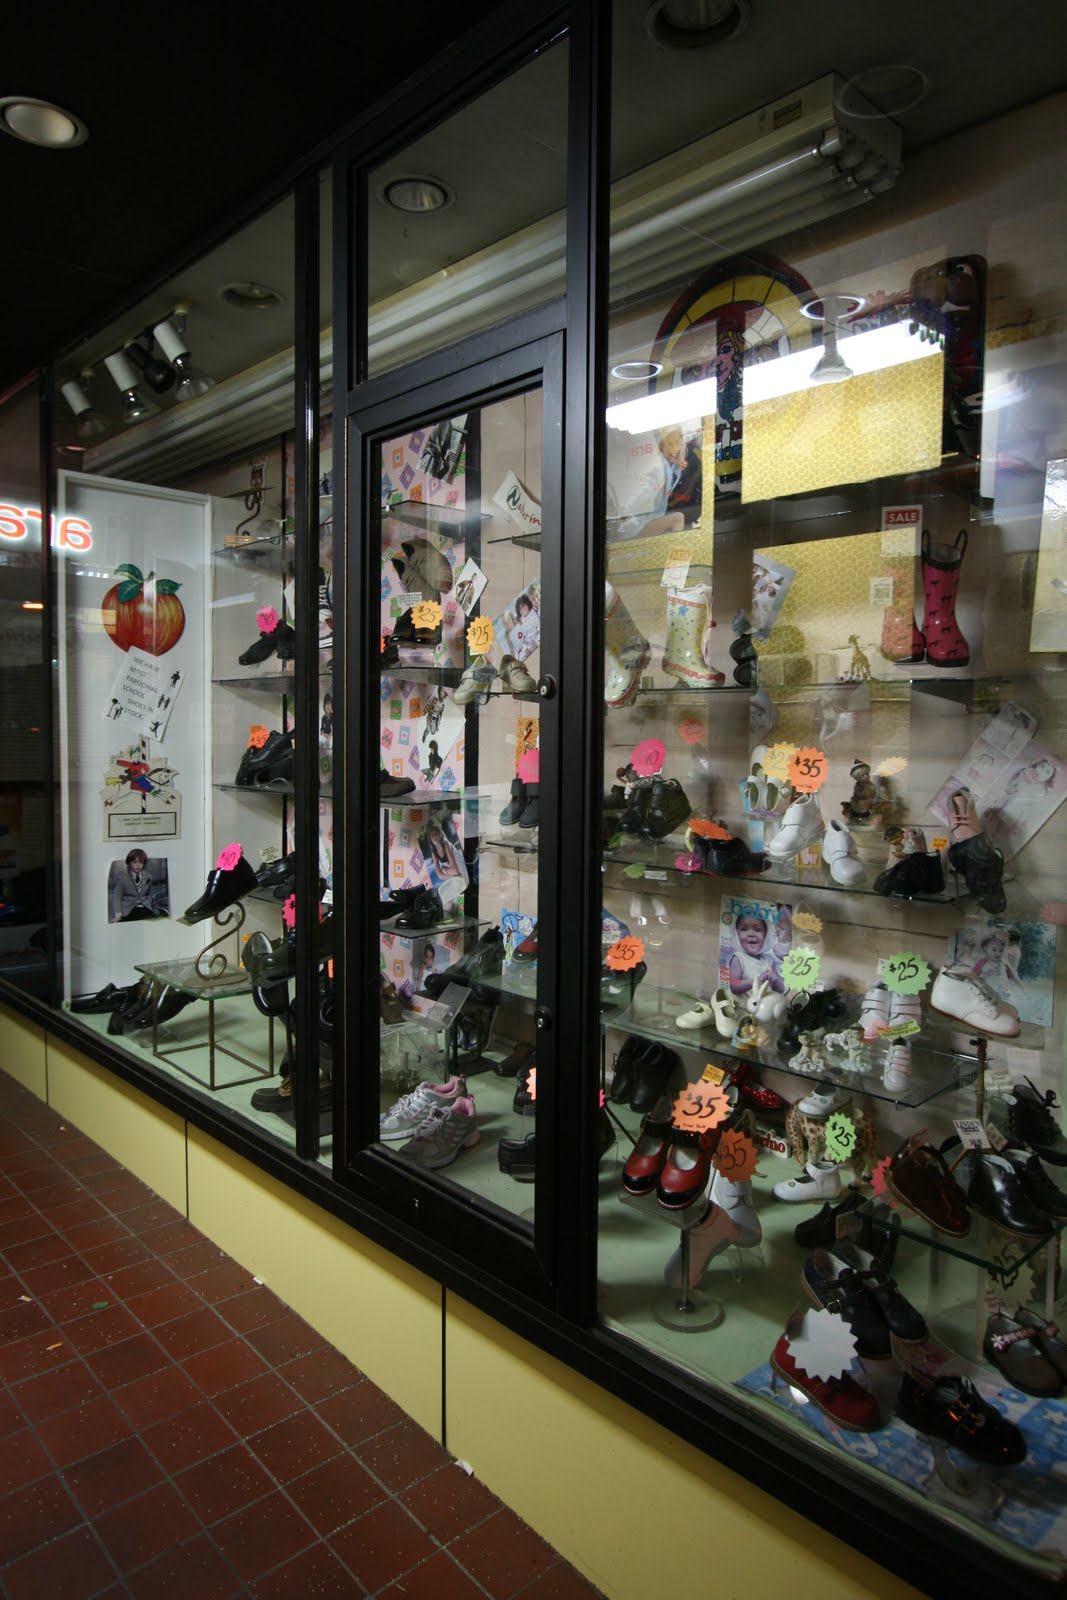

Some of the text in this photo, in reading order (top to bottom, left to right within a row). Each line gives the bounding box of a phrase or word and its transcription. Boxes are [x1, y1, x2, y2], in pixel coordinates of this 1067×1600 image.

[506, 486, 541, 526] Naturin
[889, 513, 917, 522] SALE
[418, 605, 440, 623] $25
[471, 624, 489, 646] $25
[130, 666, 147, 677] MOST
[133, 657, 160, 672] WE HAVE
[122, 685, 145, 699] SCHOOL
[126, 675, 158, 693] PAROCHIAL
[127, 698, 147, 711] SHOES
[794, 756, 823, 778] $35
[222, 851, 236, 866] $40
[730, 899, 784, 924] baby
[613, 943, 639, 960] $35
[788, 955, 815, 976] $25
[888, 957, 919, 982] $25
[682, 1093, 722, 1118] $35
[831, 1121, 853, 1147] $25
